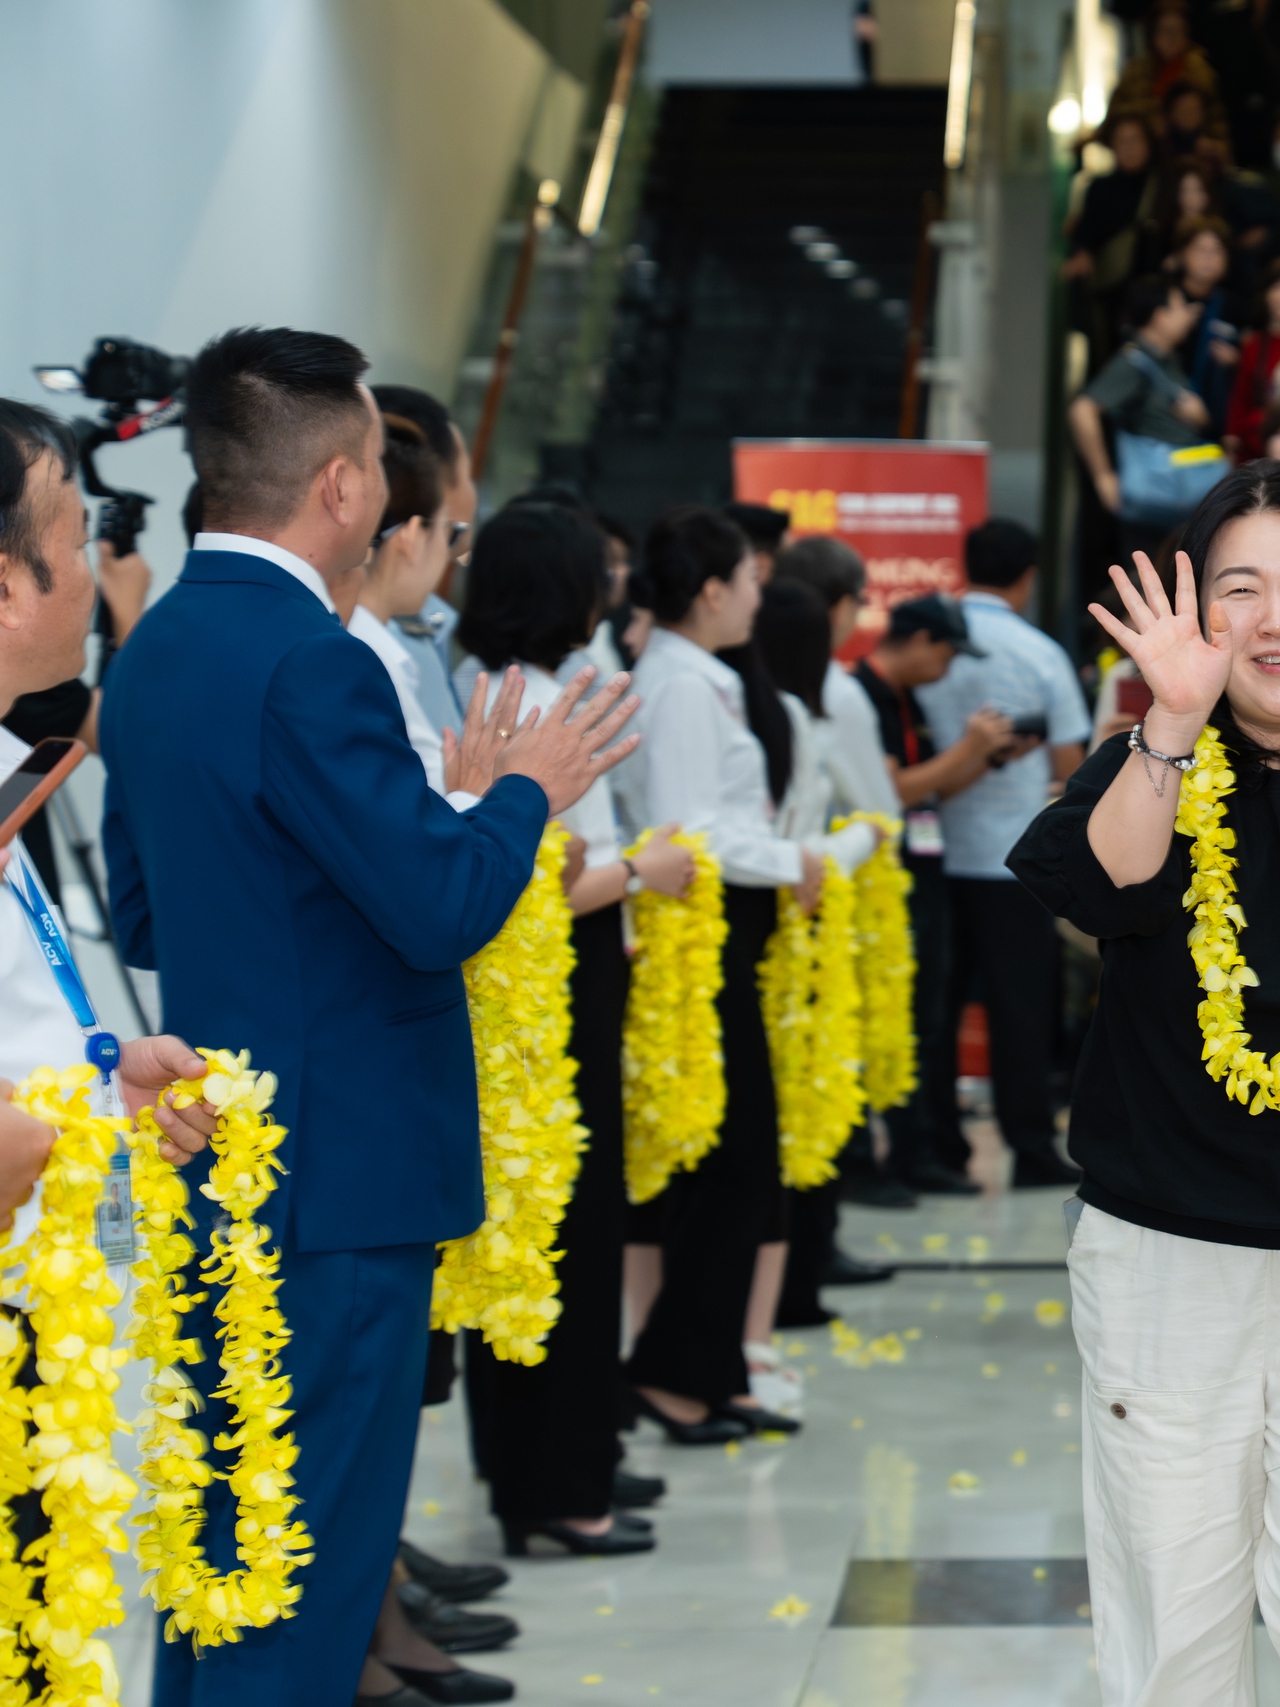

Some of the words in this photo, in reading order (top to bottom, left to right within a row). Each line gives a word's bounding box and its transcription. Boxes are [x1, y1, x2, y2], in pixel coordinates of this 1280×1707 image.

[40, 913, 57, 937] ACV
[41, 941, 62, 967] ACV
[101, 1048, 115, 1056] ACV
